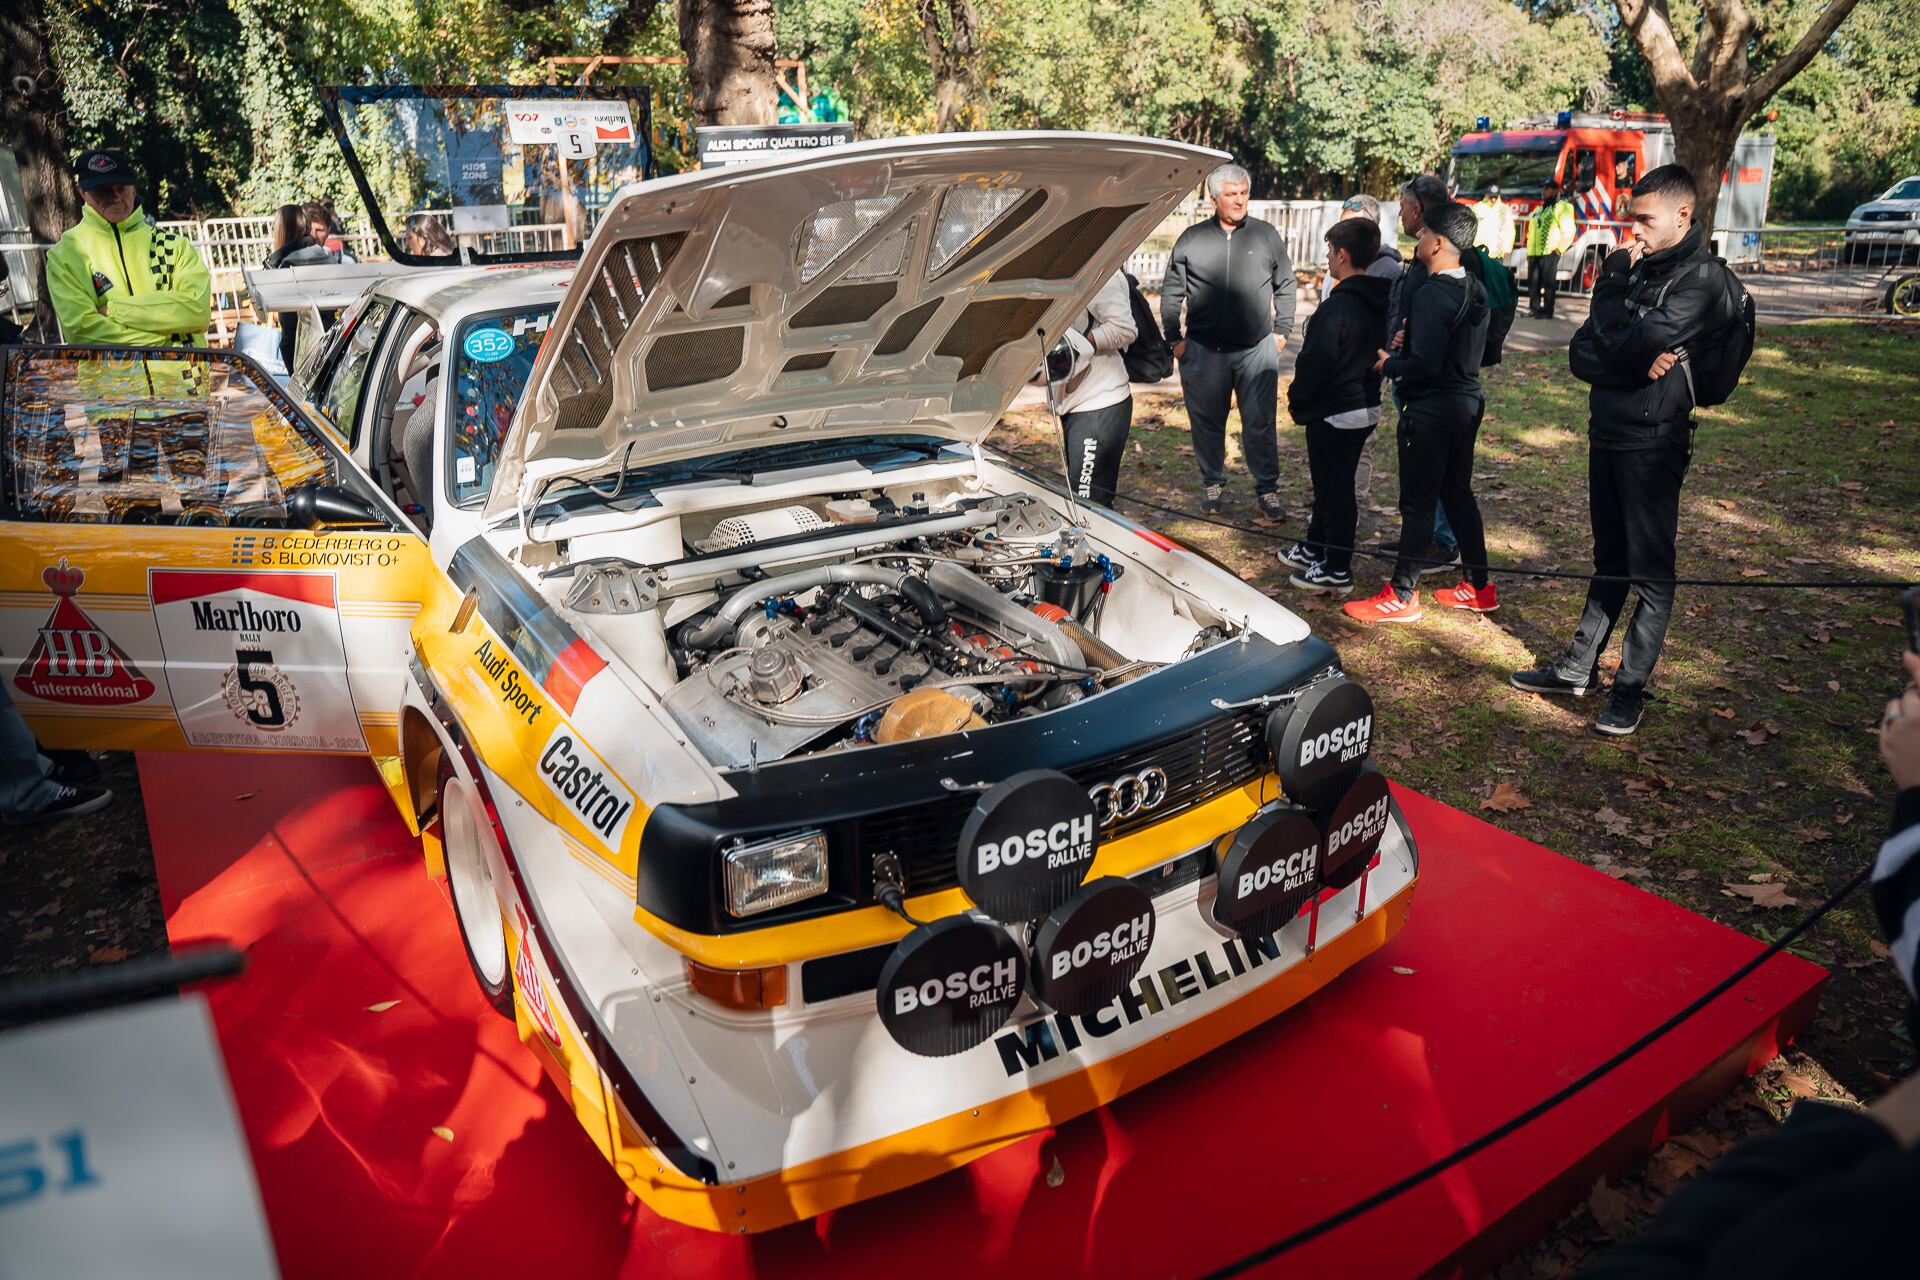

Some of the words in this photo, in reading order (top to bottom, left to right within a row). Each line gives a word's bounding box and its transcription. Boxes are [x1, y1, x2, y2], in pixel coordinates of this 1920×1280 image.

[570, 134, 583, 154] 5
[707, 139, 732, 151] AUDI
[733, 137, 768, 150] SPORT
[769, 135, 819, 150] QUATTRO
[819, 135, 832, 146] S1
[462, 162, 486, 170] KIDS
[462, 171, 488, 180] ZONE
[470, 337, 508, 353] 352
[1078, 445, 1097, 498] LACOSTE
[263, 537, 278, 550] B.
[281, 537, 383, 551] CEDERBERG
[261, 552, 276, 565] S.
[279, 552, 375, 566] BLOMQVIST
[191, 601, 302, 634] Marlboro
[239, 634, 262, 643] RALLY
[38, 628, 119, 679] HB
[33, 679, 140, 700] international
[236, 649, 285, 725] 5
[474, 640, 510, 680] Audi
[501, 667, 541, 726] Sport
[1299, 715, 1371, 768] BOSCH
[1340, 740, 1370, 763] RALLYE
[540, 735, 631, 839] Castrol
[1327, 796, 1389, 857] BOSCH
[1361, 817, 1386, 844] RALLYE
[977, 814, 1094, 876] BOSCH
[1047, 841, 1092, 869] RALLYE
[1237, 844, 1319, 900] BOSCH
[1283, 868, 1316, 893] RALLYE
[1051, 912, 1151, 980] BOSCH
[1110, 937, 1148, 966] RALLYE
[894, 957, 1018, 1016] BOSCH
[969, 982, 1016, 1010] RALLYE
[994, 931, 1282, 1077] MICHELIN
